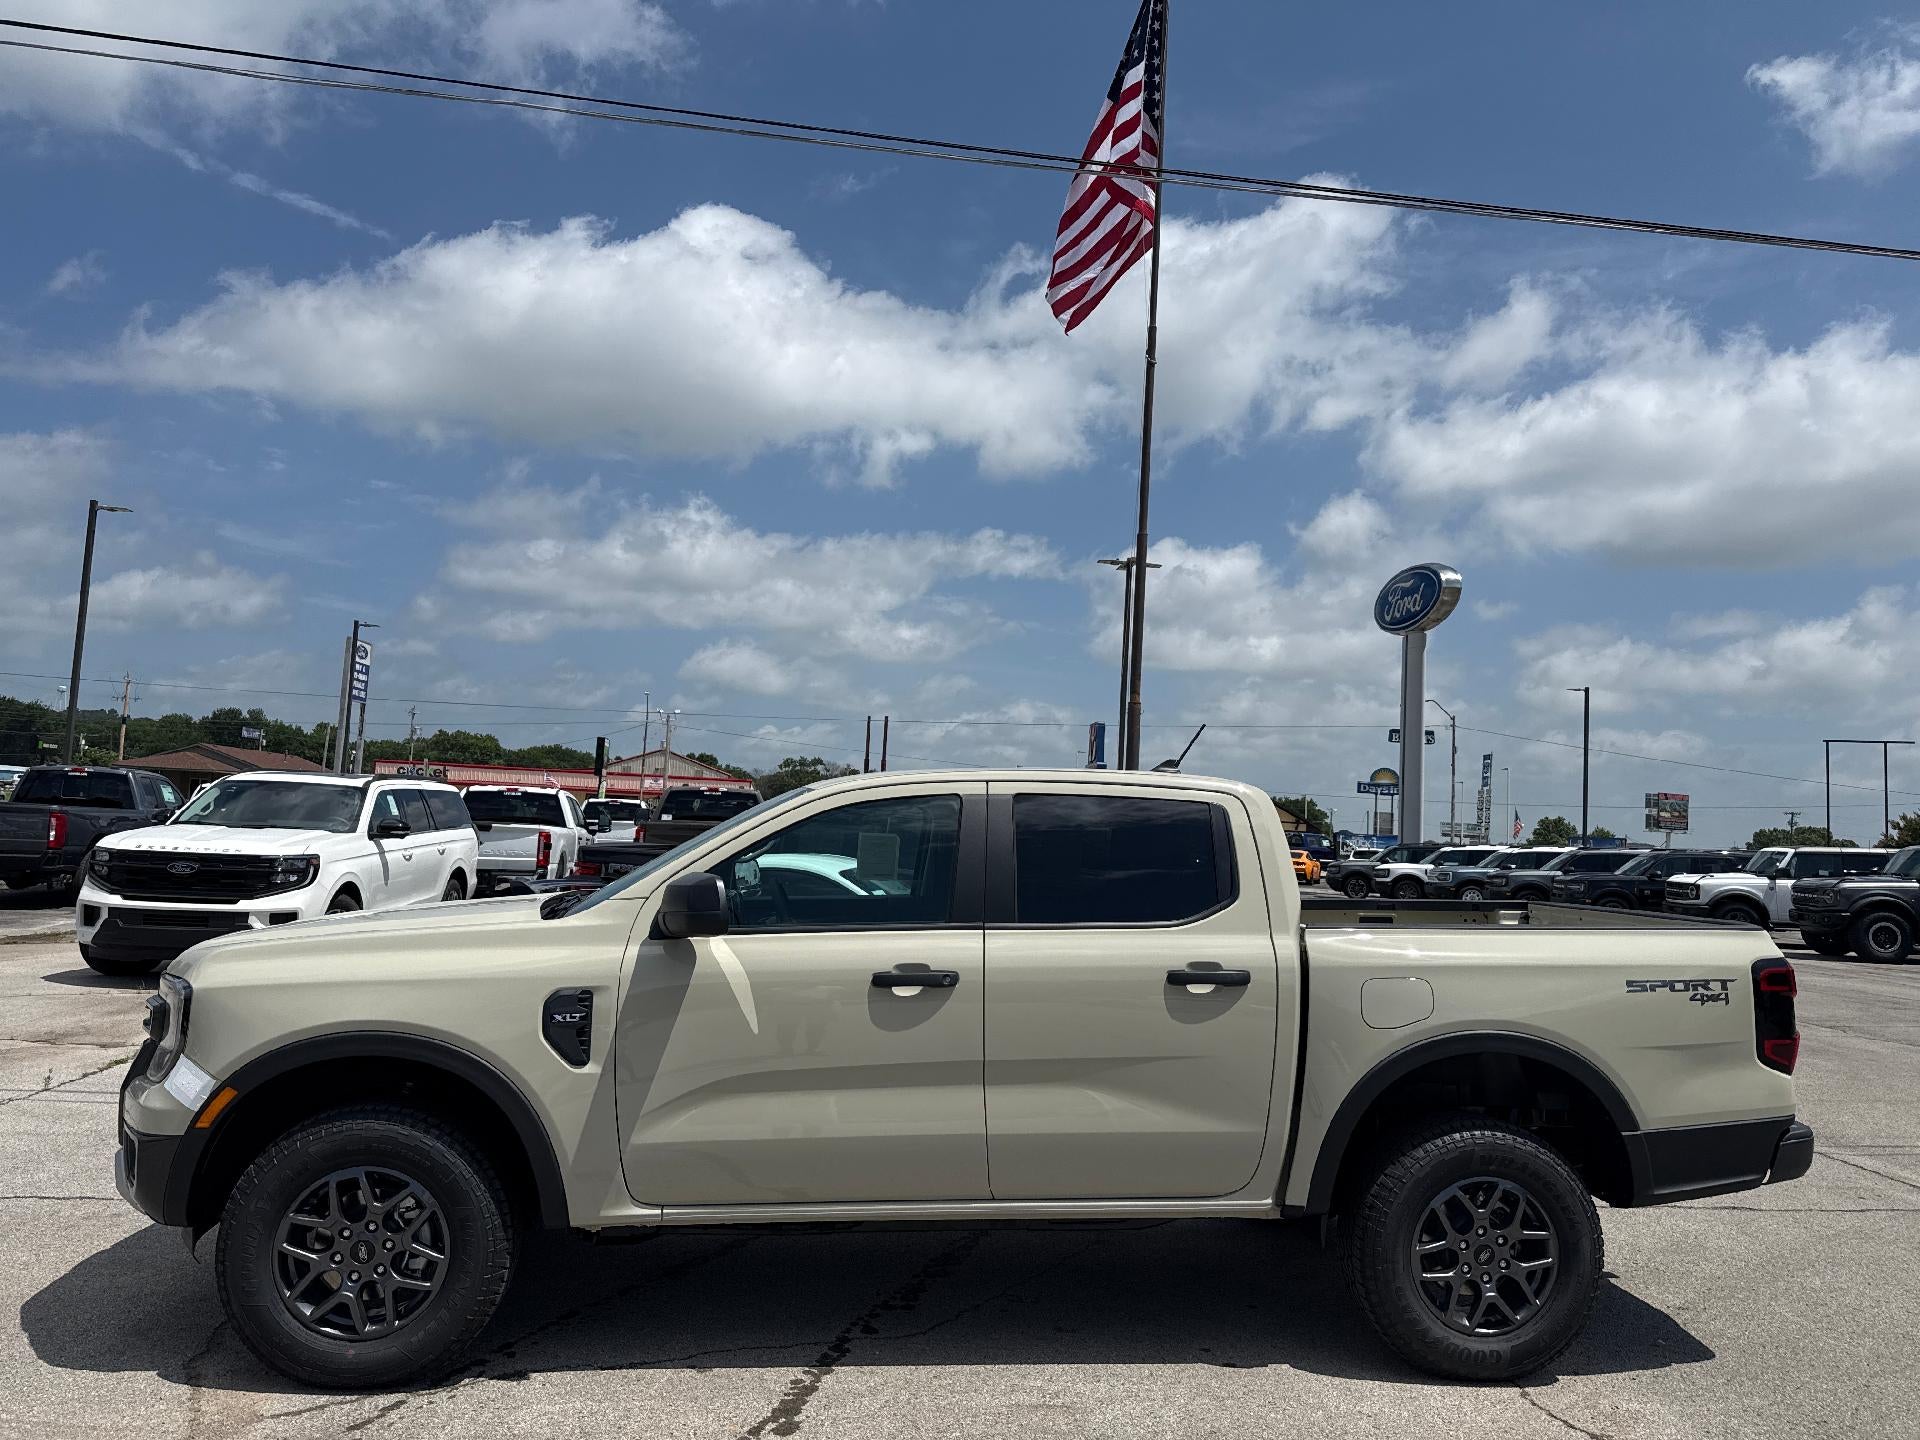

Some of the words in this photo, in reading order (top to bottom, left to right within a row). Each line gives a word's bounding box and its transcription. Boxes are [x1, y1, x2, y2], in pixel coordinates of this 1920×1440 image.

[1384, 579, 1425, 622] Ford
[397, 764, 449, 778] ccket
[1625, 979, 1739, 994] SPORT
[551, 1012, 587, 1023] XLT
